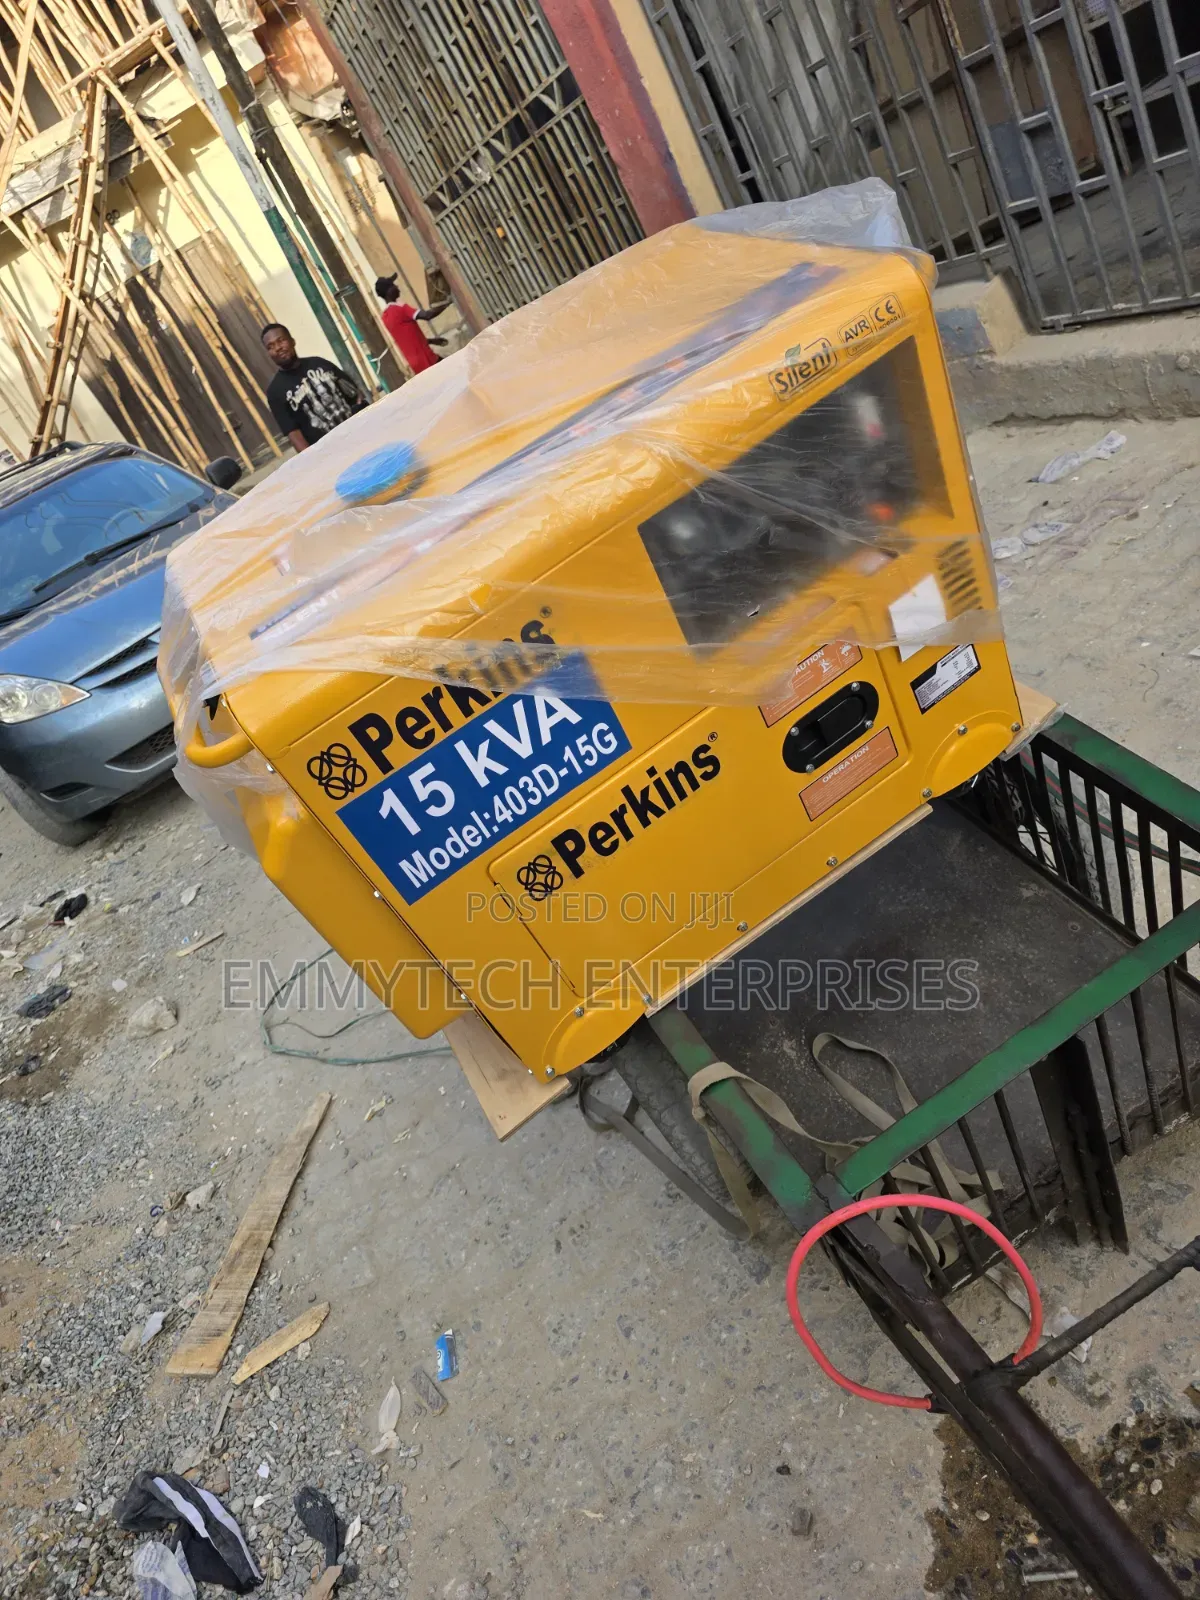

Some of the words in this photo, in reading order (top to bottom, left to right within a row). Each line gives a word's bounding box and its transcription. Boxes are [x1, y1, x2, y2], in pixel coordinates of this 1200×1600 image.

[843, 318, 870, 343] AVR
[793, 649, 825, 676] AUTION
[378, 761, 456, 836] 15
[453, 684, 583, 788] kVA
[821, 744, 870, 784] OPERATION
[398, 721, 619, 889] Model:403D-15G
